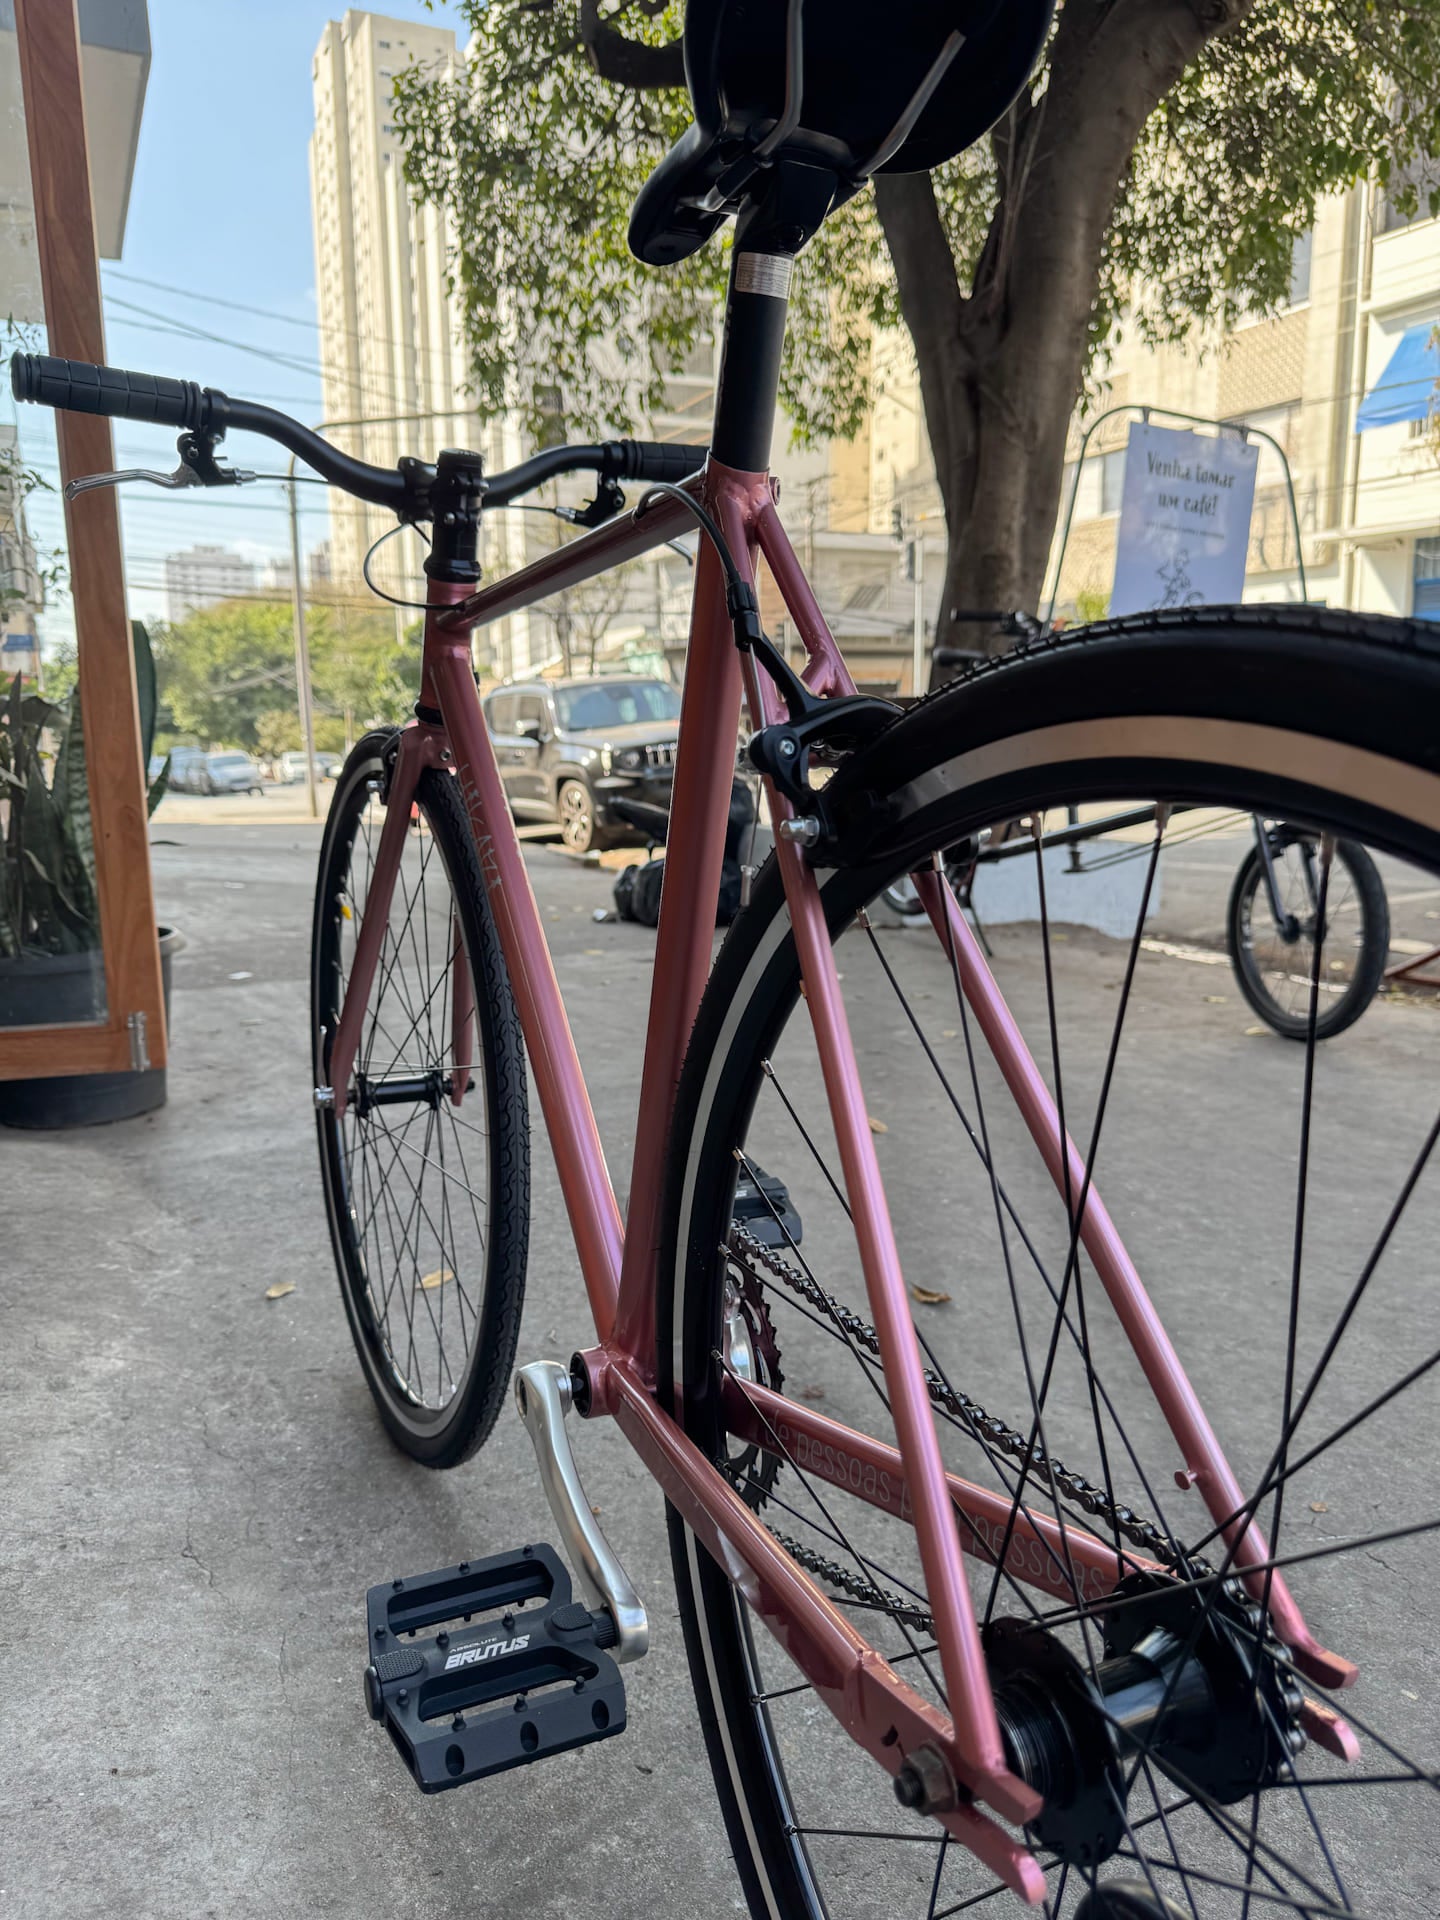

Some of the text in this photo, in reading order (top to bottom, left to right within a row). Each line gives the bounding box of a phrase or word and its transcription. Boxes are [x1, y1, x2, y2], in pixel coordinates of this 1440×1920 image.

[1147, 451, 1236, 488] Venha tomar
[1158, 493, 1218, 516] um café!
[794, 1431, 891, 1503] pessoas
[444, 1634, 531, 1670] BRUTUS
[449, 1637, 498, 1654] ABSOLUTE
